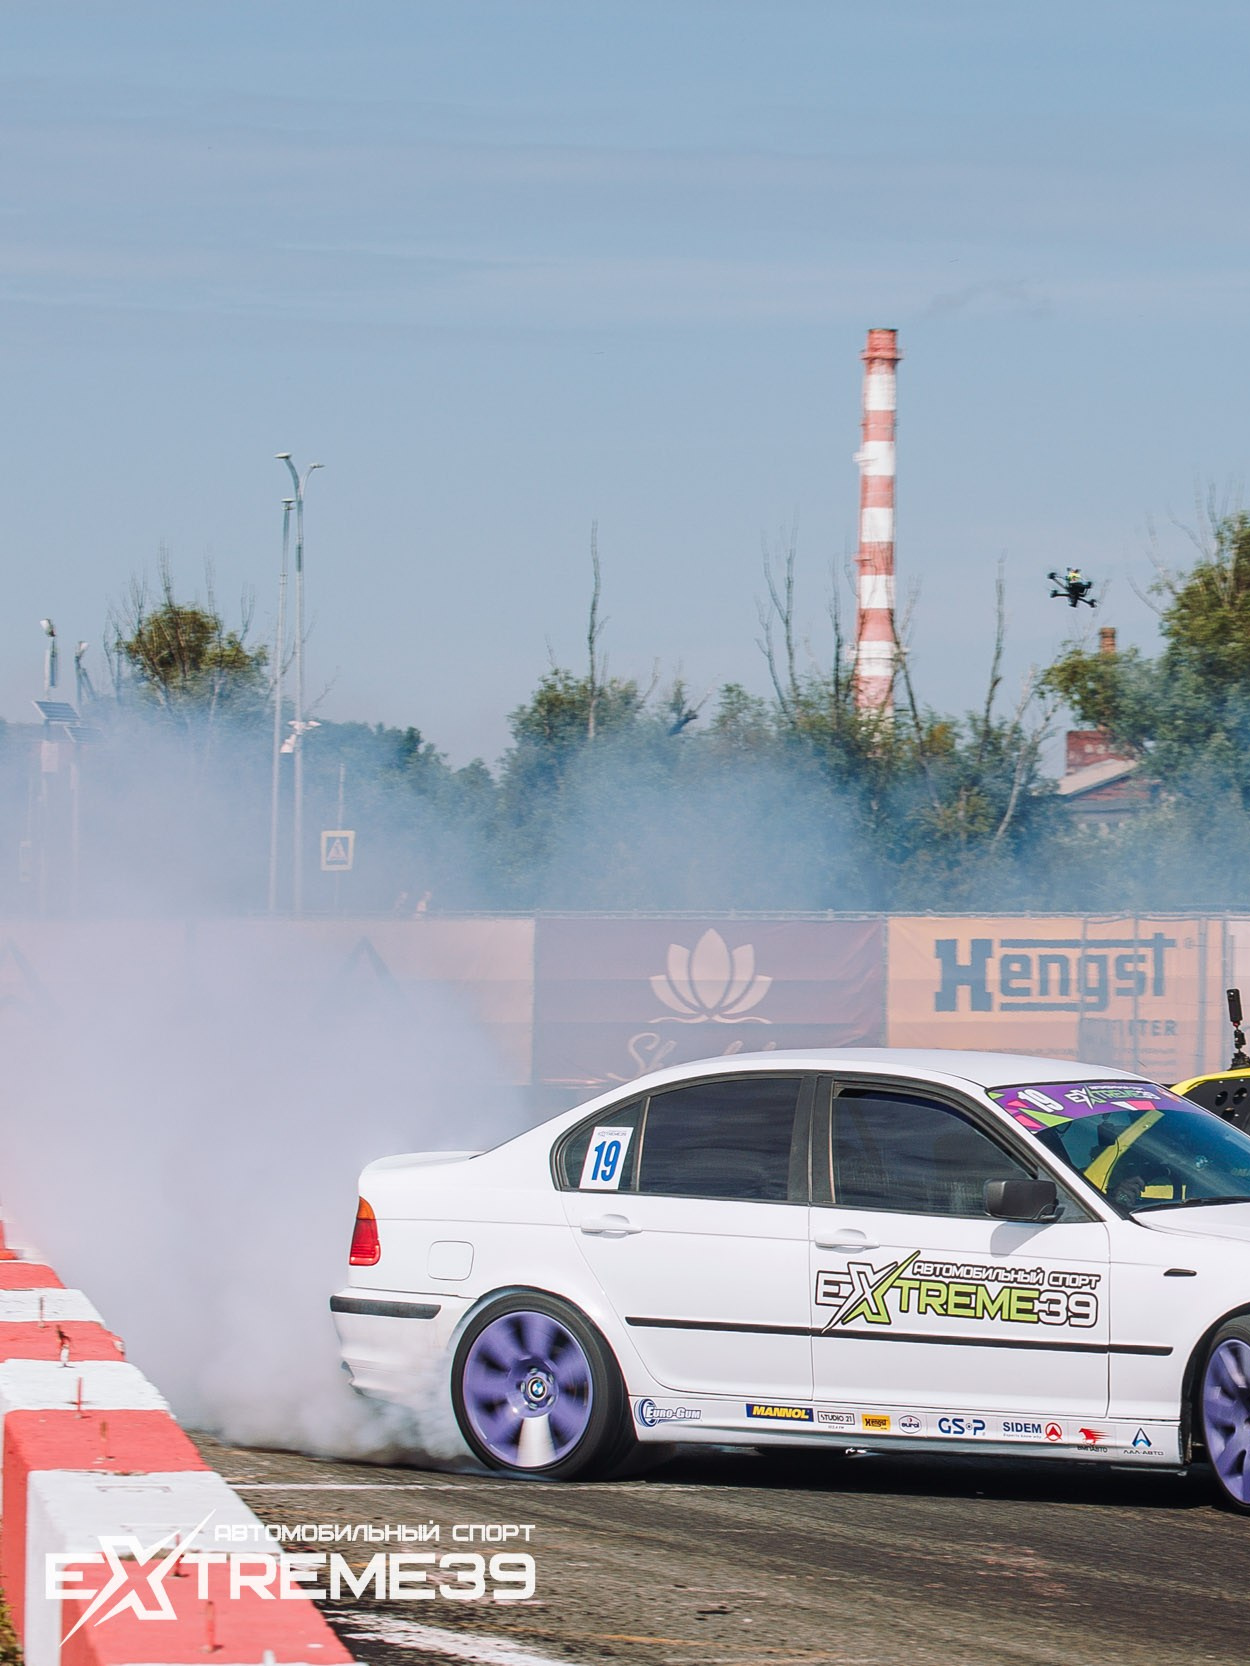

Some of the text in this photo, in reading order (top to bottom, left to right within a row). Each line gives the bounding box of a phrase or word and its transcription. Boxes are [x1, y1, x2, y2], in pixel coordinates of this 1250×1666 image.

[935, 932, 1177, 1012] Hengst
[1017, 1088, 1064, 1113] 19
[591, 1140, 622, 1182] 19
[912, 1260, 1101, 1289] АВТОМОБИЛЬНЫЙ СПОРТ
[815, 1250, 1099, 1334] EXTREME39
[752, 1406, 809, 1420] MANNOL
[820, 1414, 844, 1422] STUDIO
[1003, 1421, 1042, 1434] SIDEM
